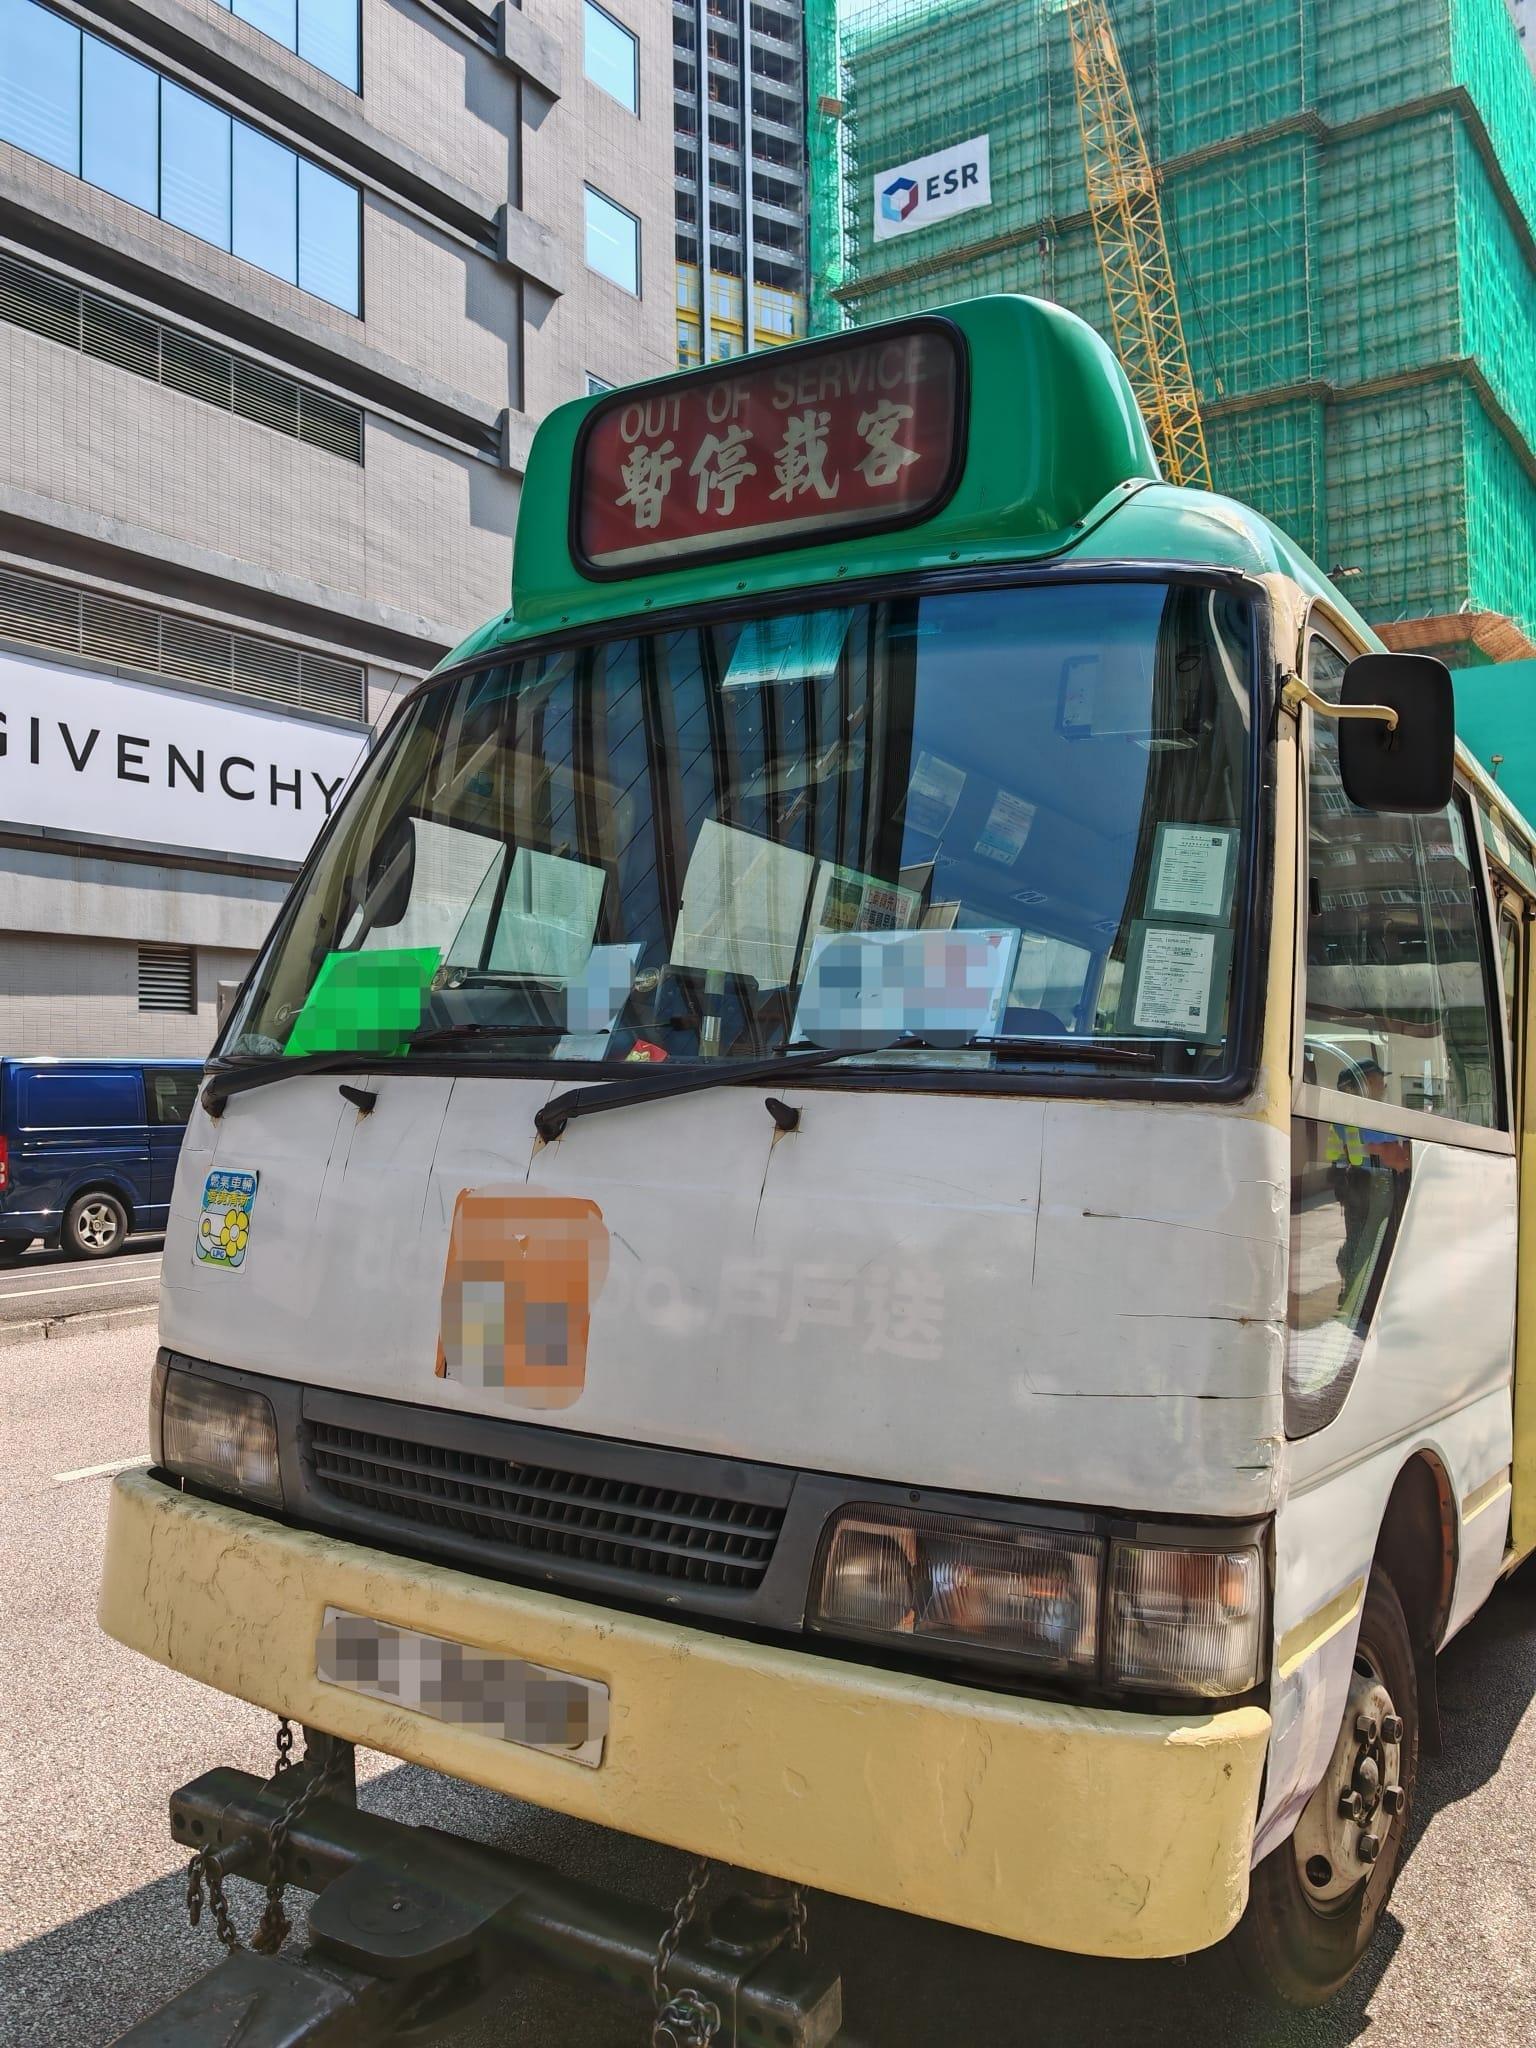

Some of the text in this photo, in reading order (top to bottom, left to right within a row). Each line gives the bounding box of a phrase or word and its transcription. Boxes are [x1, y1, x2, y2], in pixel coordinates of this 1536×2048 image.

[926, 162, 979, 201] ESR
[620, 342, 927, 443] OUT OF SERVICE
[615, 399, 922, 529] 暫停載客
[0, 711, 345, 815] IVENCHY
[212, 1249, 225, 1258] LPG
